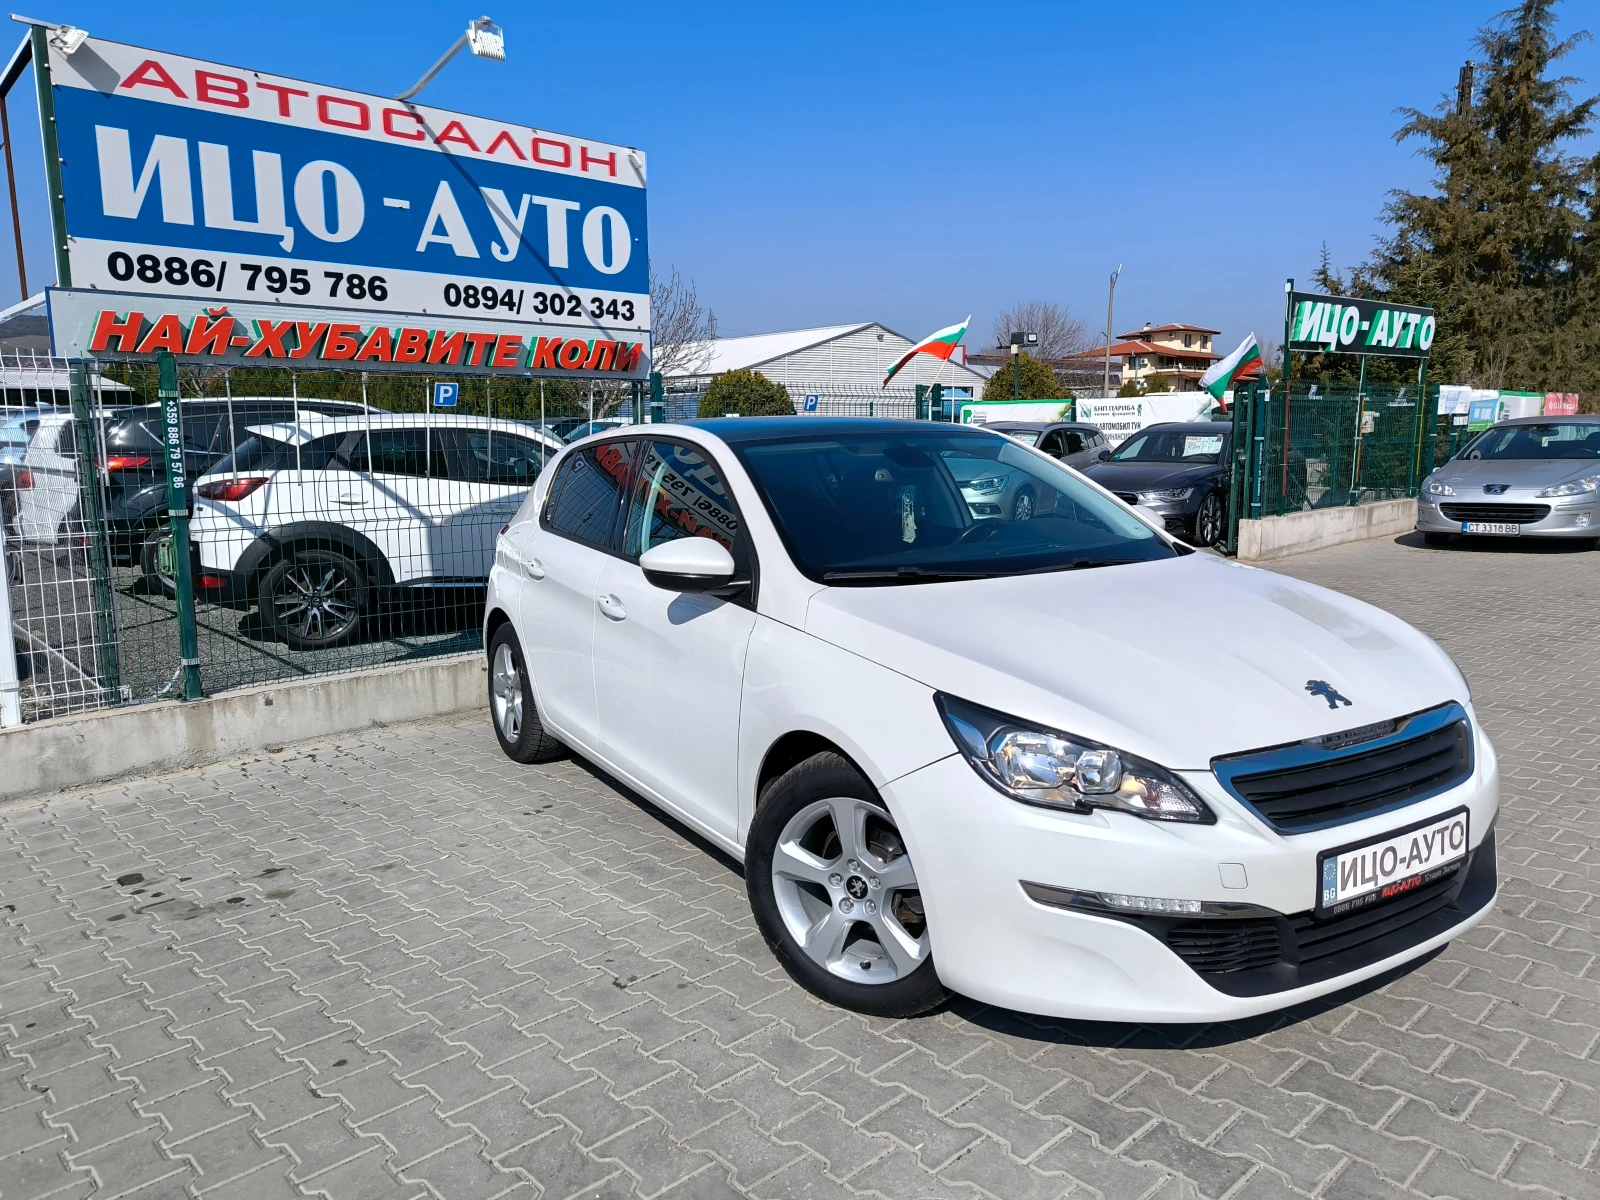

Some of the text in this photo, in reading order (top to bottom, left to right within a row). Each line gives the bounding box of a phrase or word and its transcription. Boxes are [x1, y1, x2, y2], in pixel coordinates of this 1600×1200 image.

[119, 59, 618, 178] АВТОСАЛОН
[107, 251, 389, 302] 0886/ 795 786
[443, 283, 635, 322] 0894/ 302 343
[1299, 300, 1436, 351] ИЦО-АУТО
[89, 305, 643, 372] НАЙ-ХУБАВИТЕ КОЛИ
[1100, 422, 1131, 431] АВТОМОБИЛ
[1109, 404, 1136, 412] ПАРИБА
[166, 400, 184, 489] +359 886 79 57 86
[1341, 820, 1465, 892] ИЦО-АУТО
[1324, 887, 1336, 901] BG
